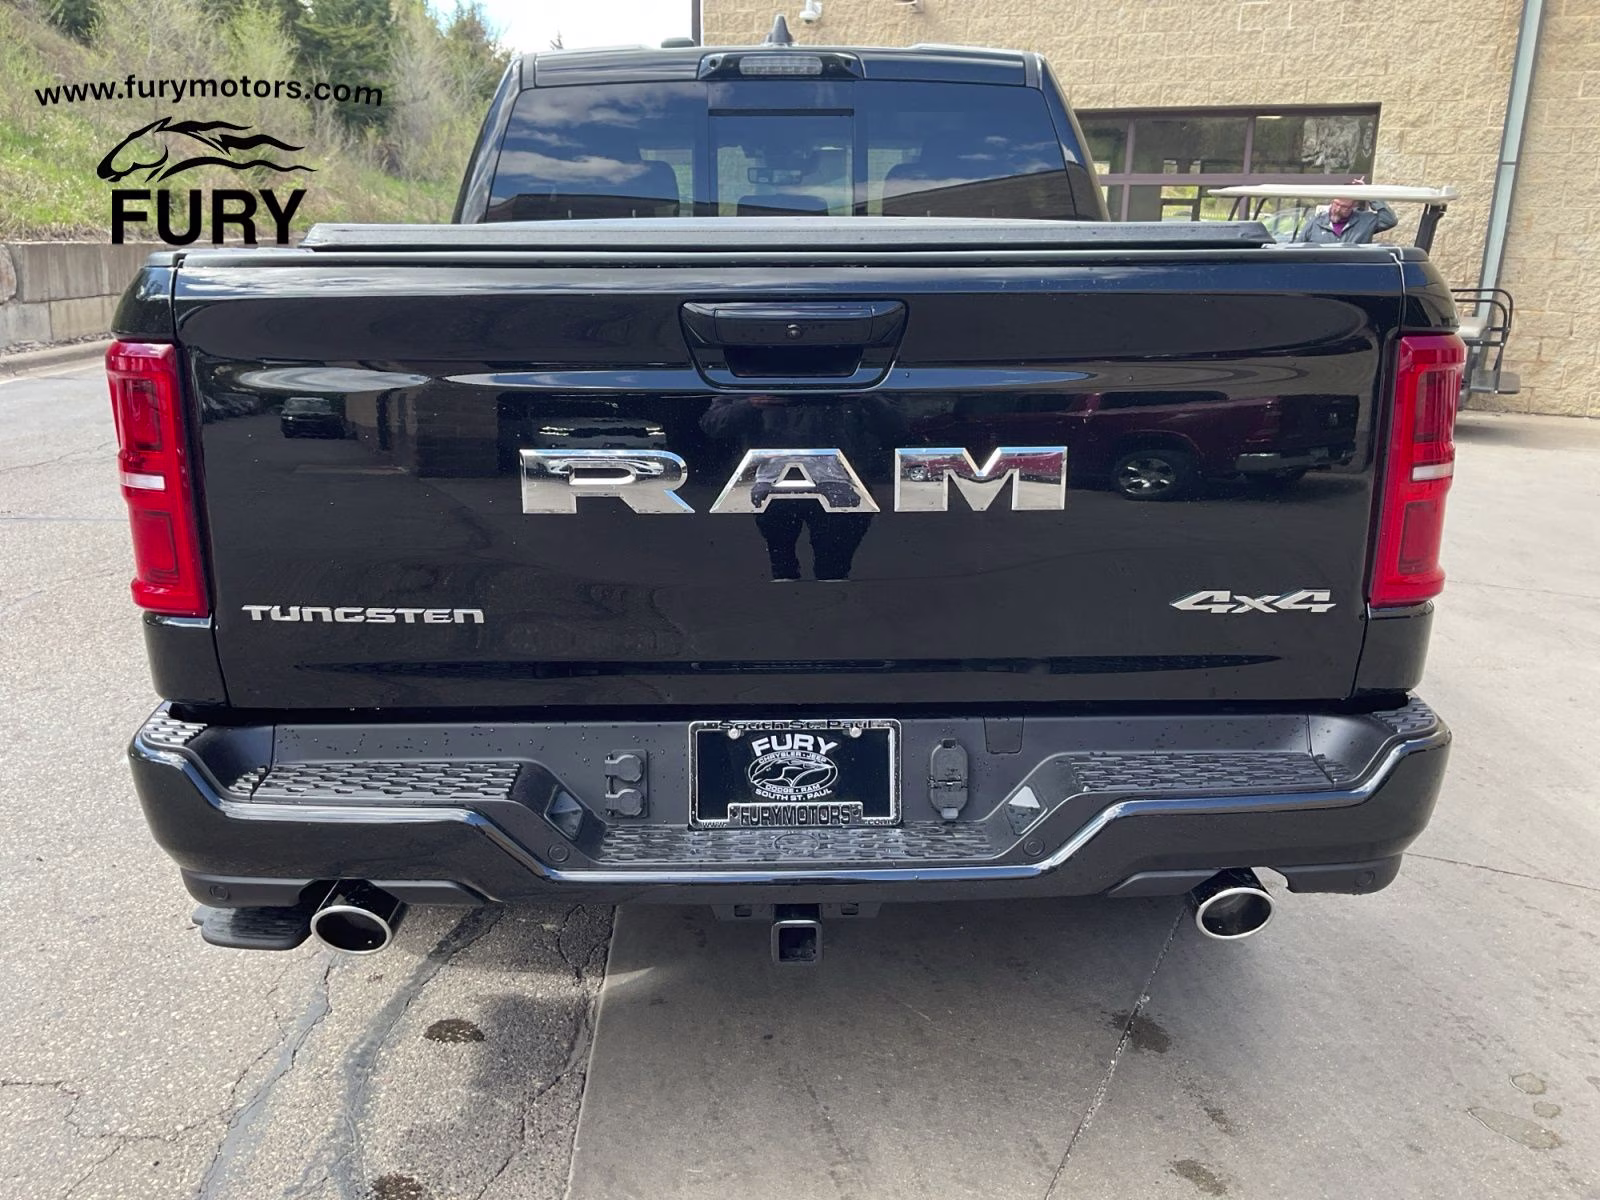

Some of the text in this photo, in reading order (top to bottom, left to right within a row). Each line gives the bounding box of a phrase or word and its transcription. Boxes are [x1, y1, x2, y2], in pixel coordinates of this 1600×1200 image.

[519, 445, 1068, 514] RAM
[241, 604, 485, 624] TUNGSTEN
[718, 719, 785, 730] South
[751, 733, 838, 757] FURY
[755, 788, 789, 801] SOUTH
[807, 788, 832, 800] PAUL
